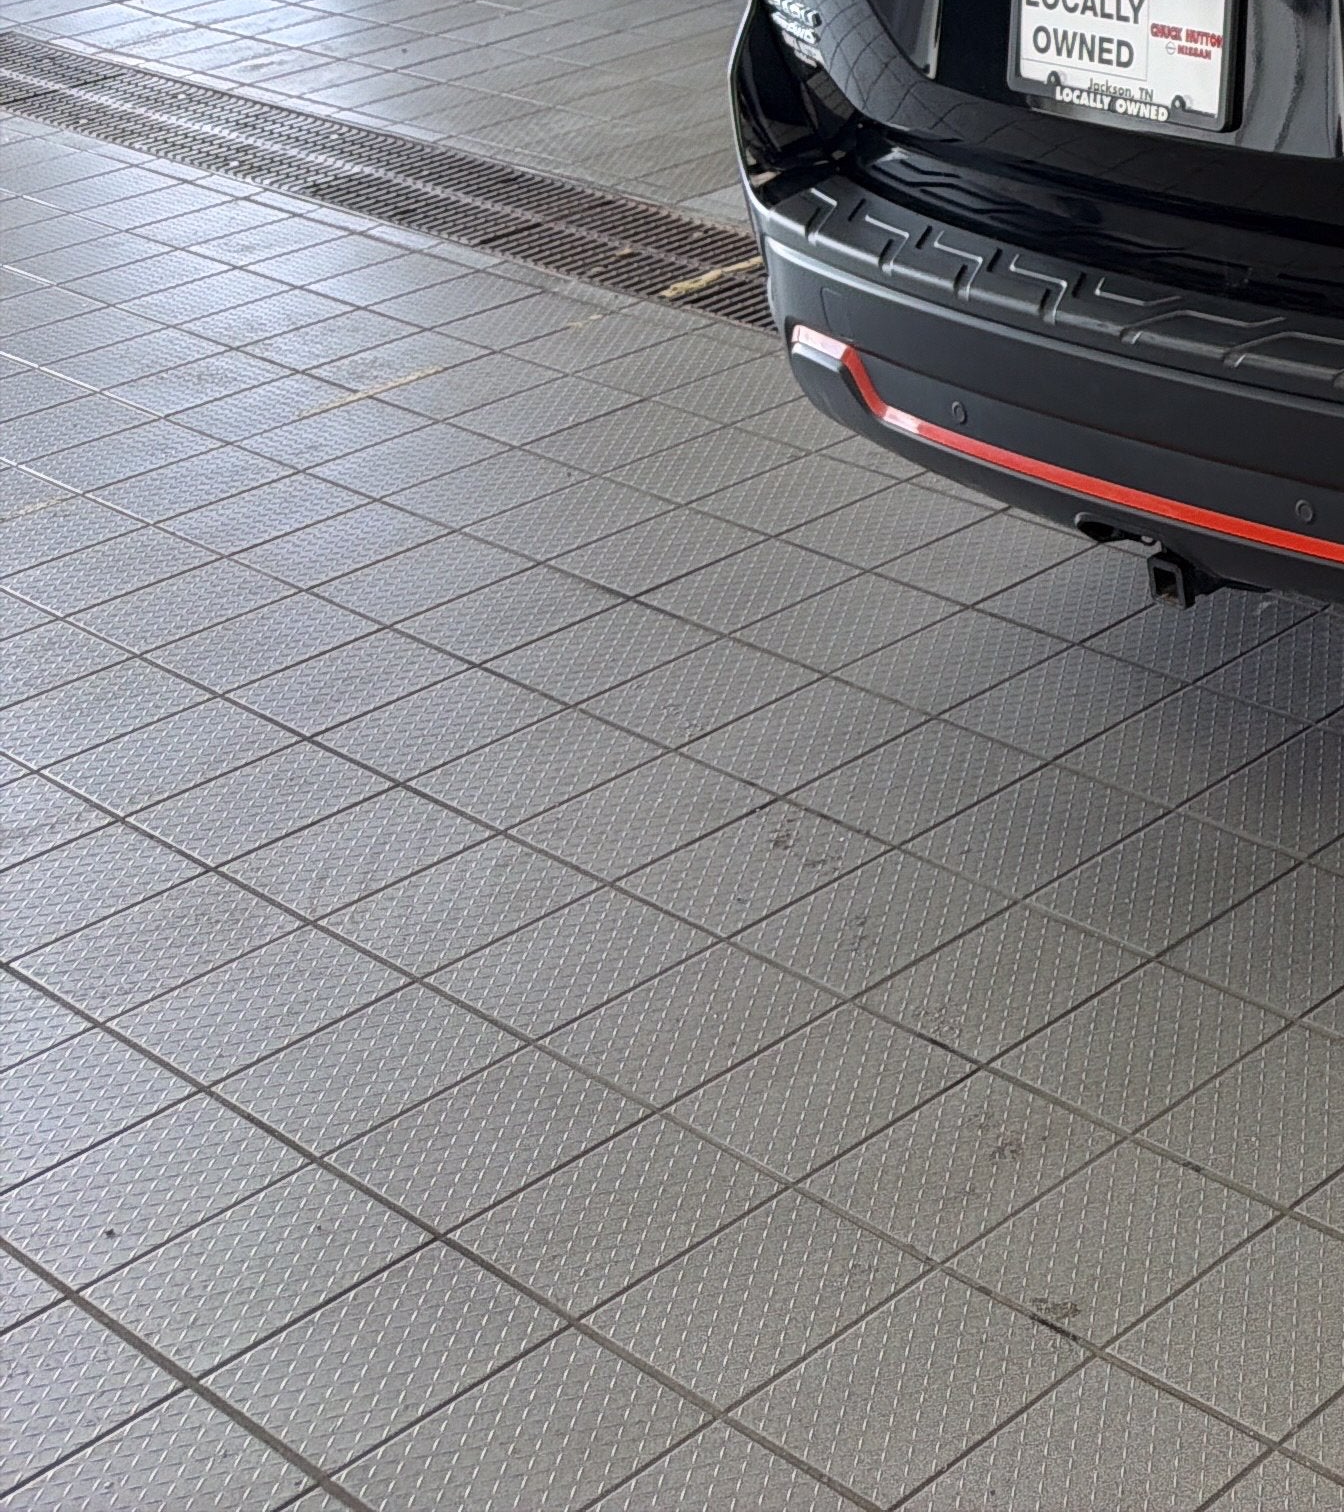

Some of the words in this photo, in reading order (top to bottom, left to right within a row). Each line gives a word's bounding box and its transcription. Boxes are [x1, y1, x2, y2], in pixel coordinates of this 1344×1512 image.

[1151, 23, 1183, 41] CHUCK
[1032, 25, 1134, 69] OWNED
[1177, 44, 1212, 61] NISSAN
[1138, 87, 1154, 102] TN
[1055, 86, 1111, 111] LOCALLY
[1115, 98, 1169, 122] OWNED
